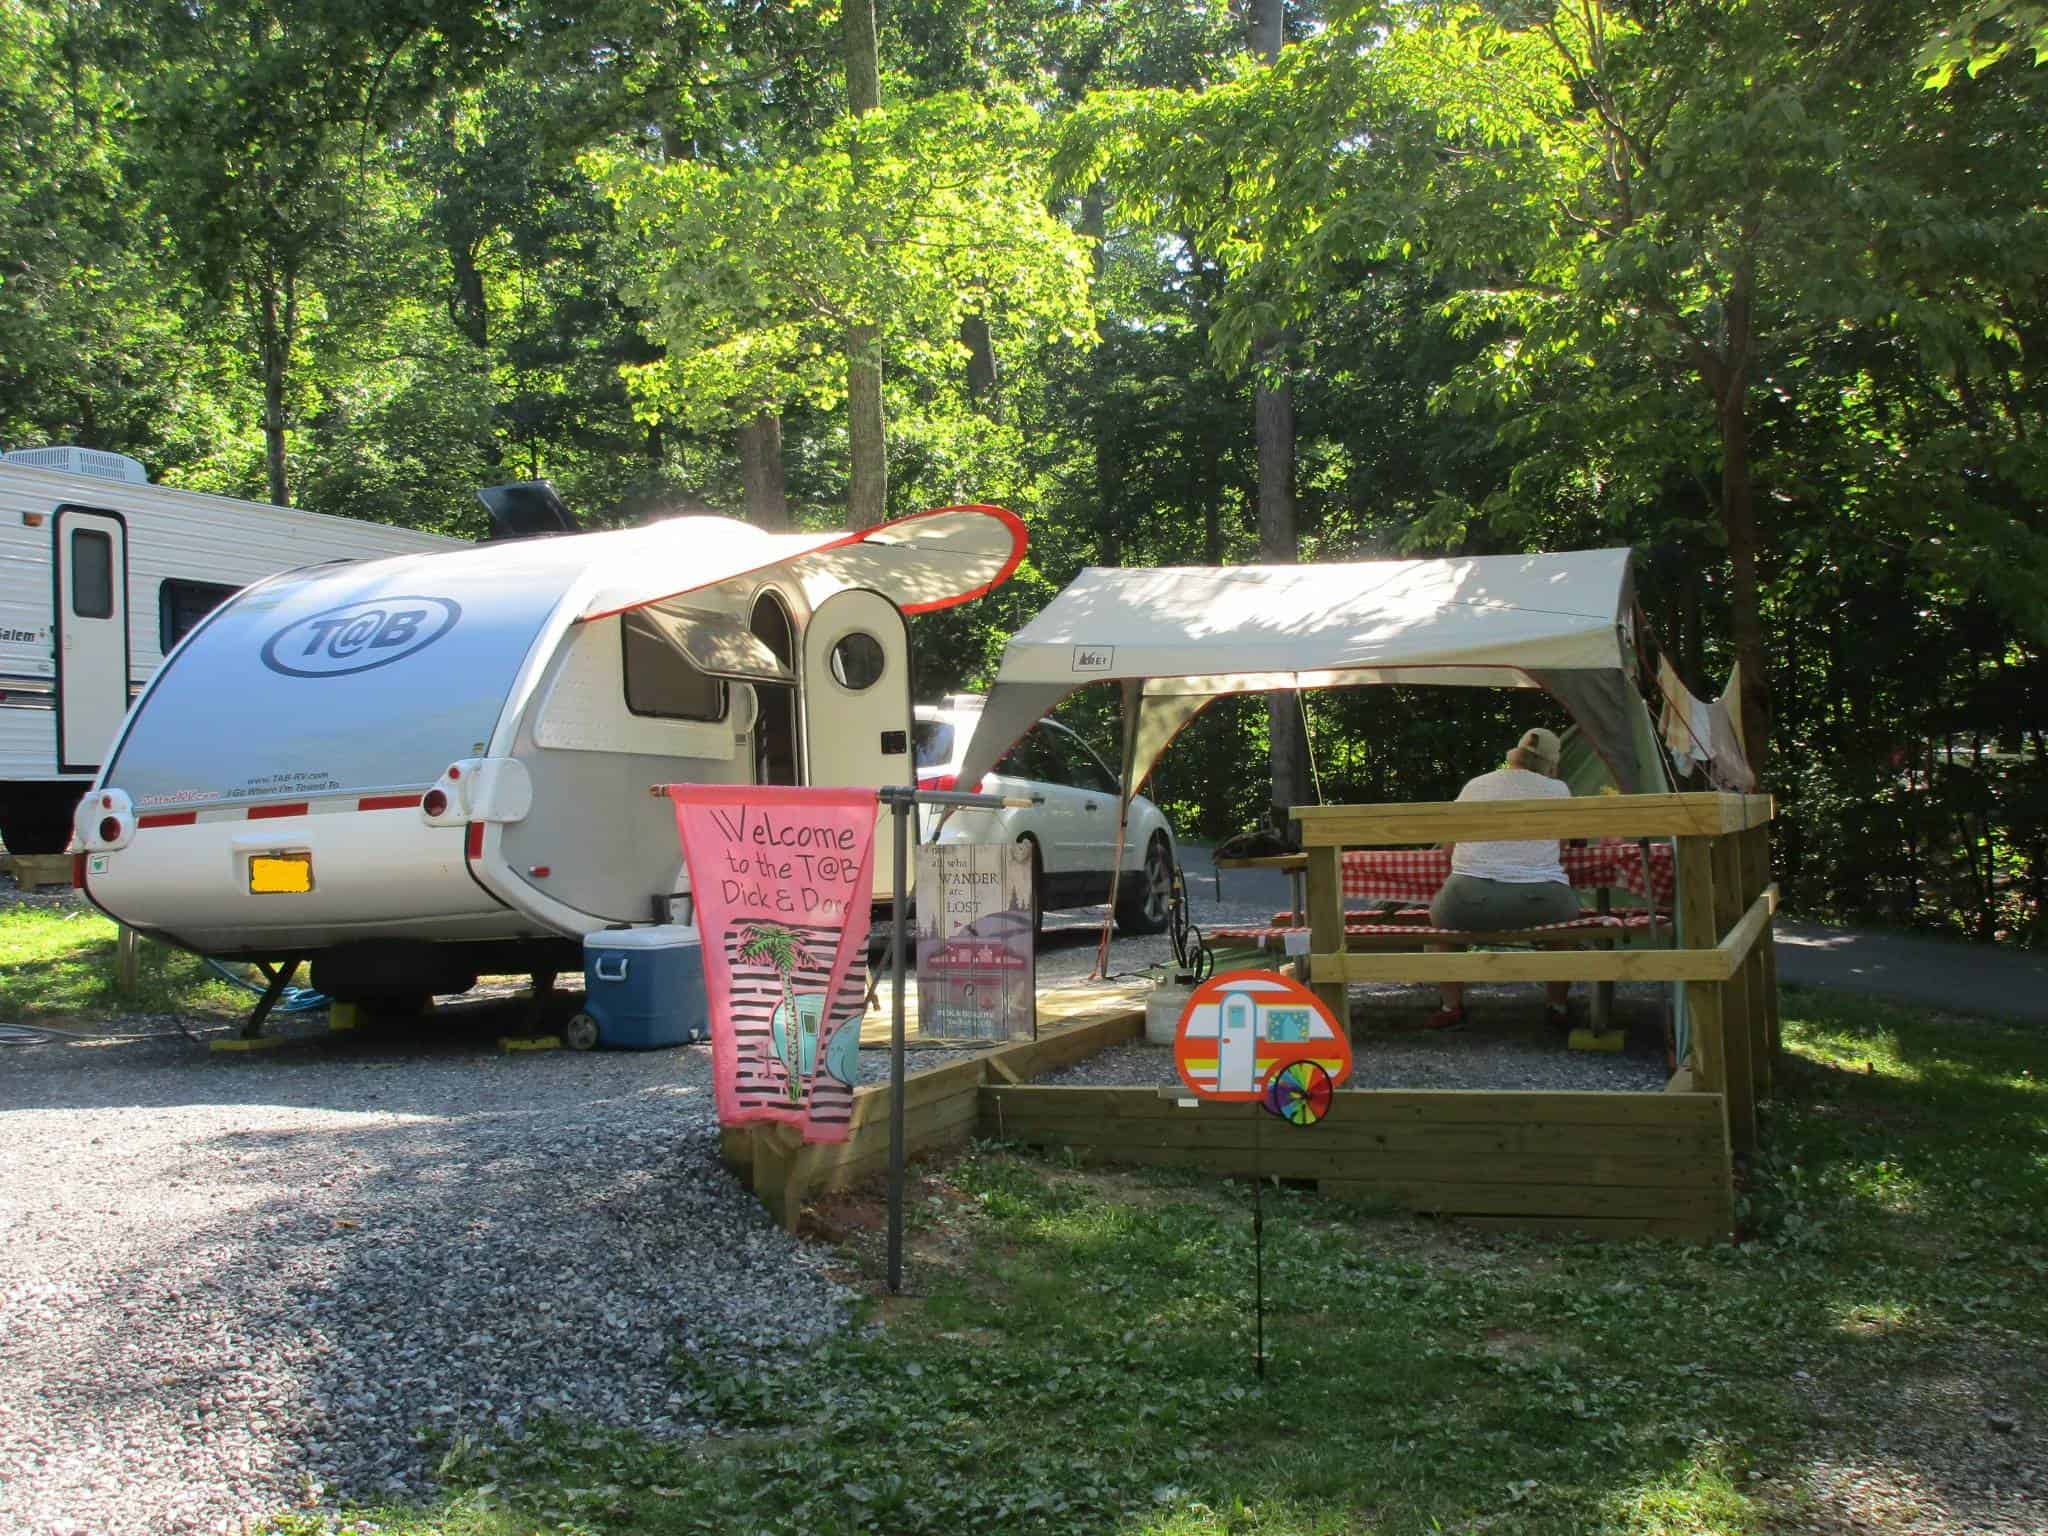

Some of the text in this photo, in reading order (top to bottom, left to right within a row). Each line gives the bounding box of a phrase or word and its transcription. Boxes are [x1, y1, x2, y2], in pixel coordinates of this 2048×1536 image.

[302, 610, 428, 658] T@B
[710, 804, 856, 850] Welcome
[726, 849, 860, 884] to the T@B
[939, 872, 1000, 885] WANDER
[722, 879, 771, 909] Dick
[946, 900, 981, 913] LOST
